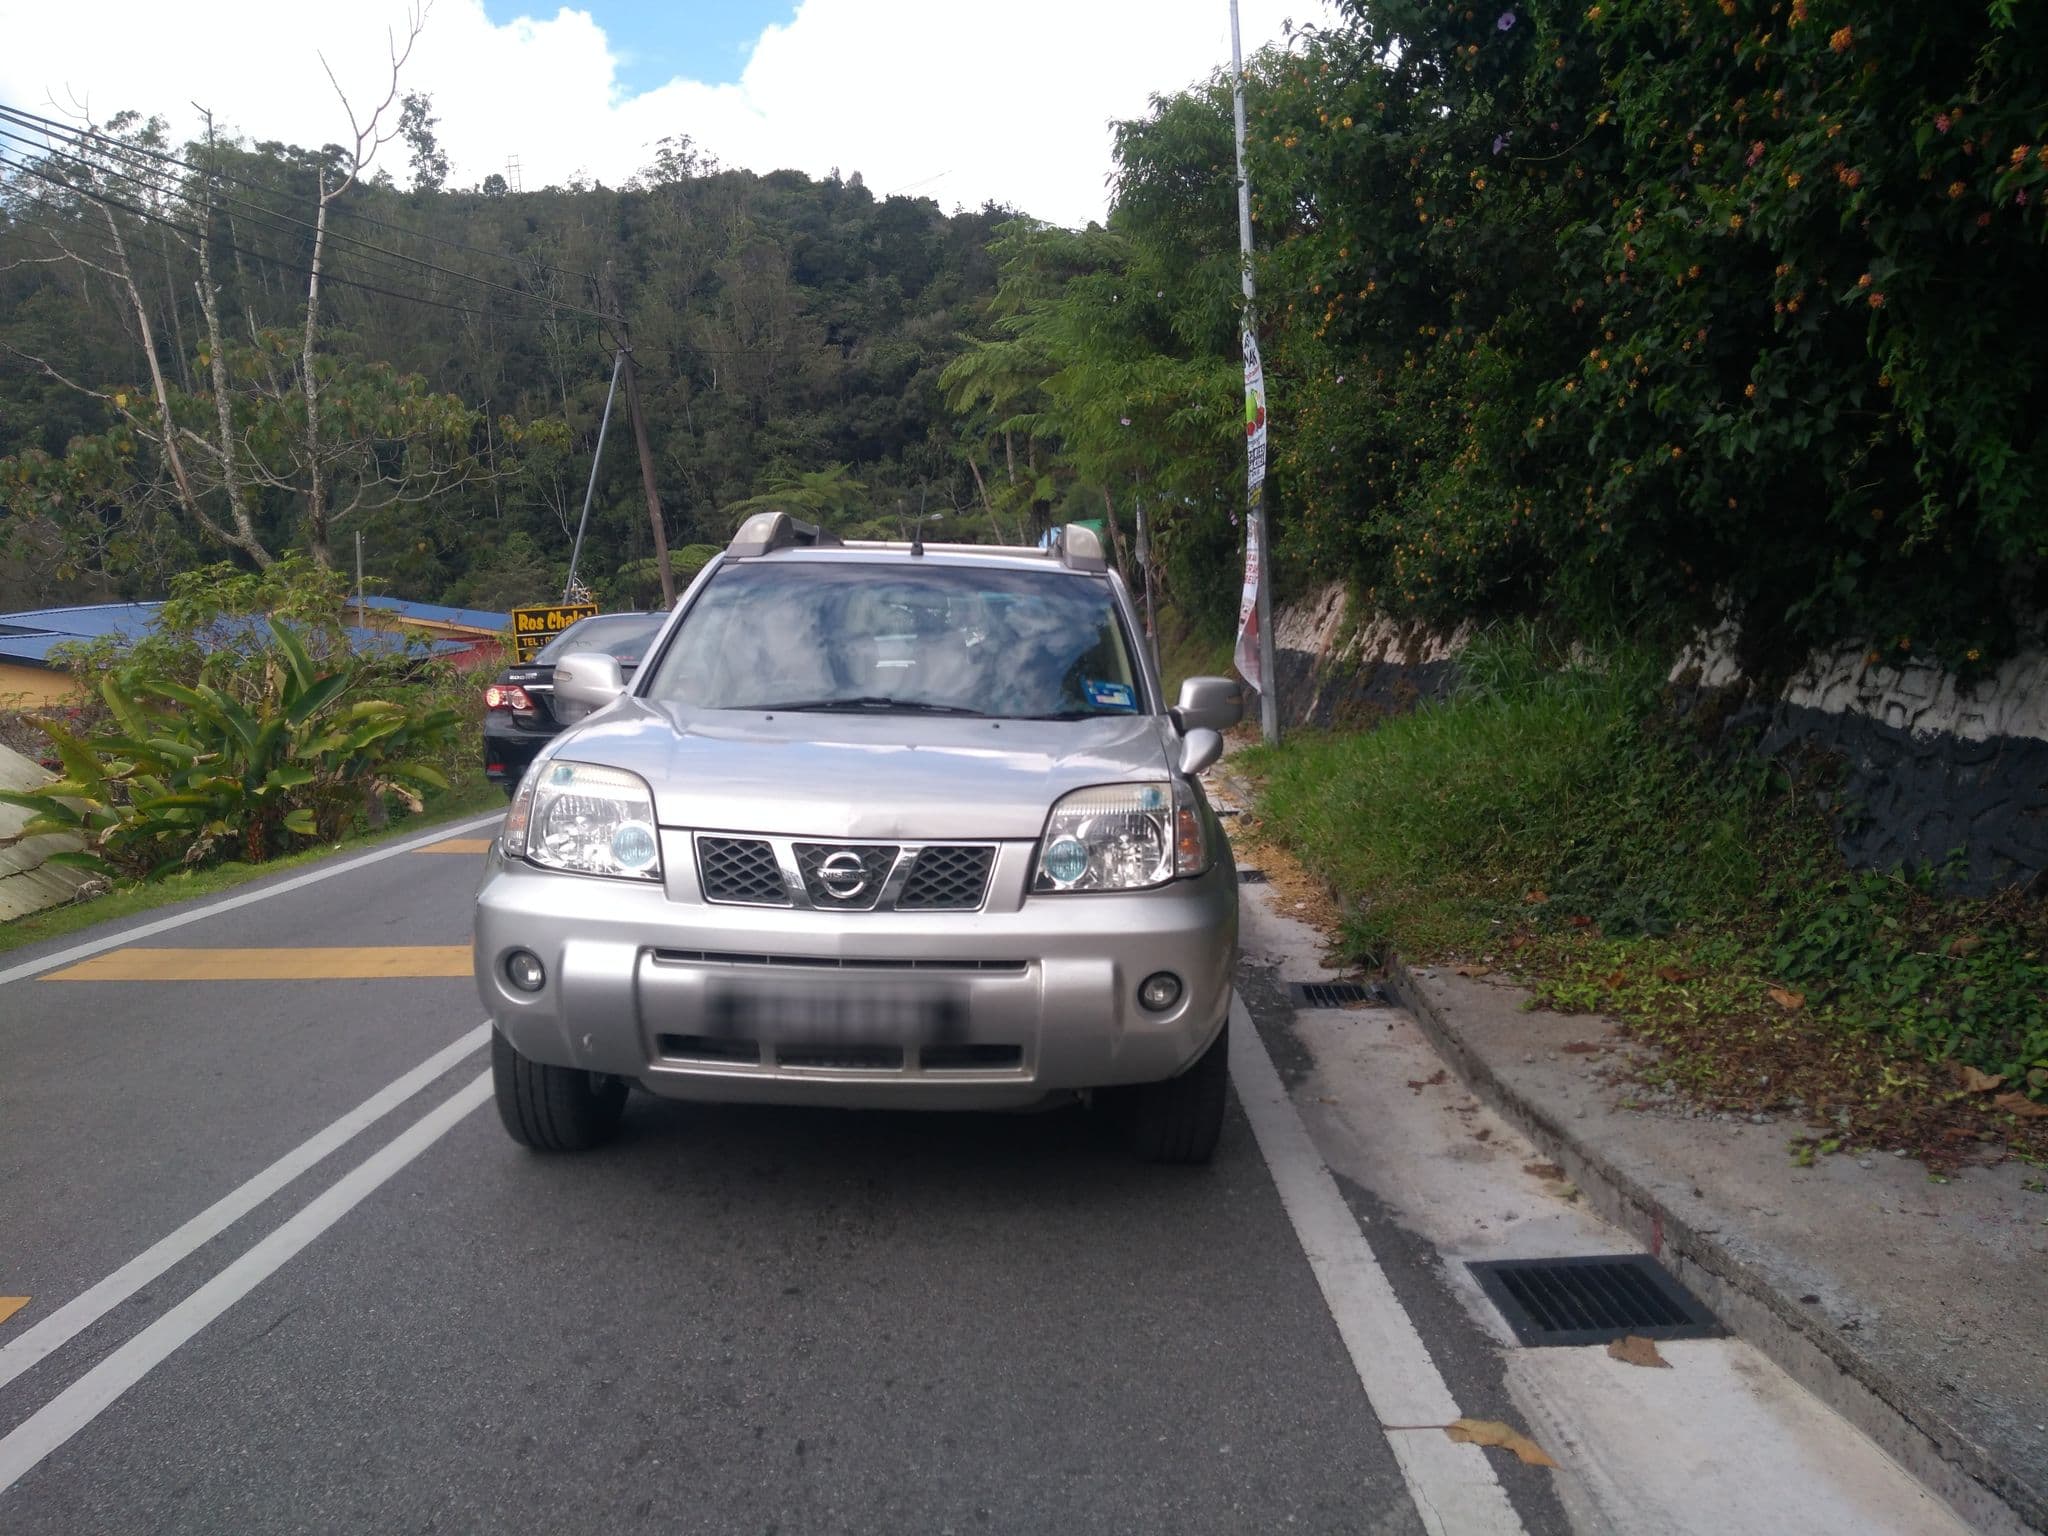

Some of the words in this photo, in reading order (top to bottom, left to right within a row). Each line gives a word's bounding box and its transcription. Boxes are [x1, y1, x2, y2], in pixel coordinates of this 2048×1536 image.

[518, 613, 545, 631] Ros
[547, 610, 592, 630] Chal
[522, 637, 538, 647] TEL
